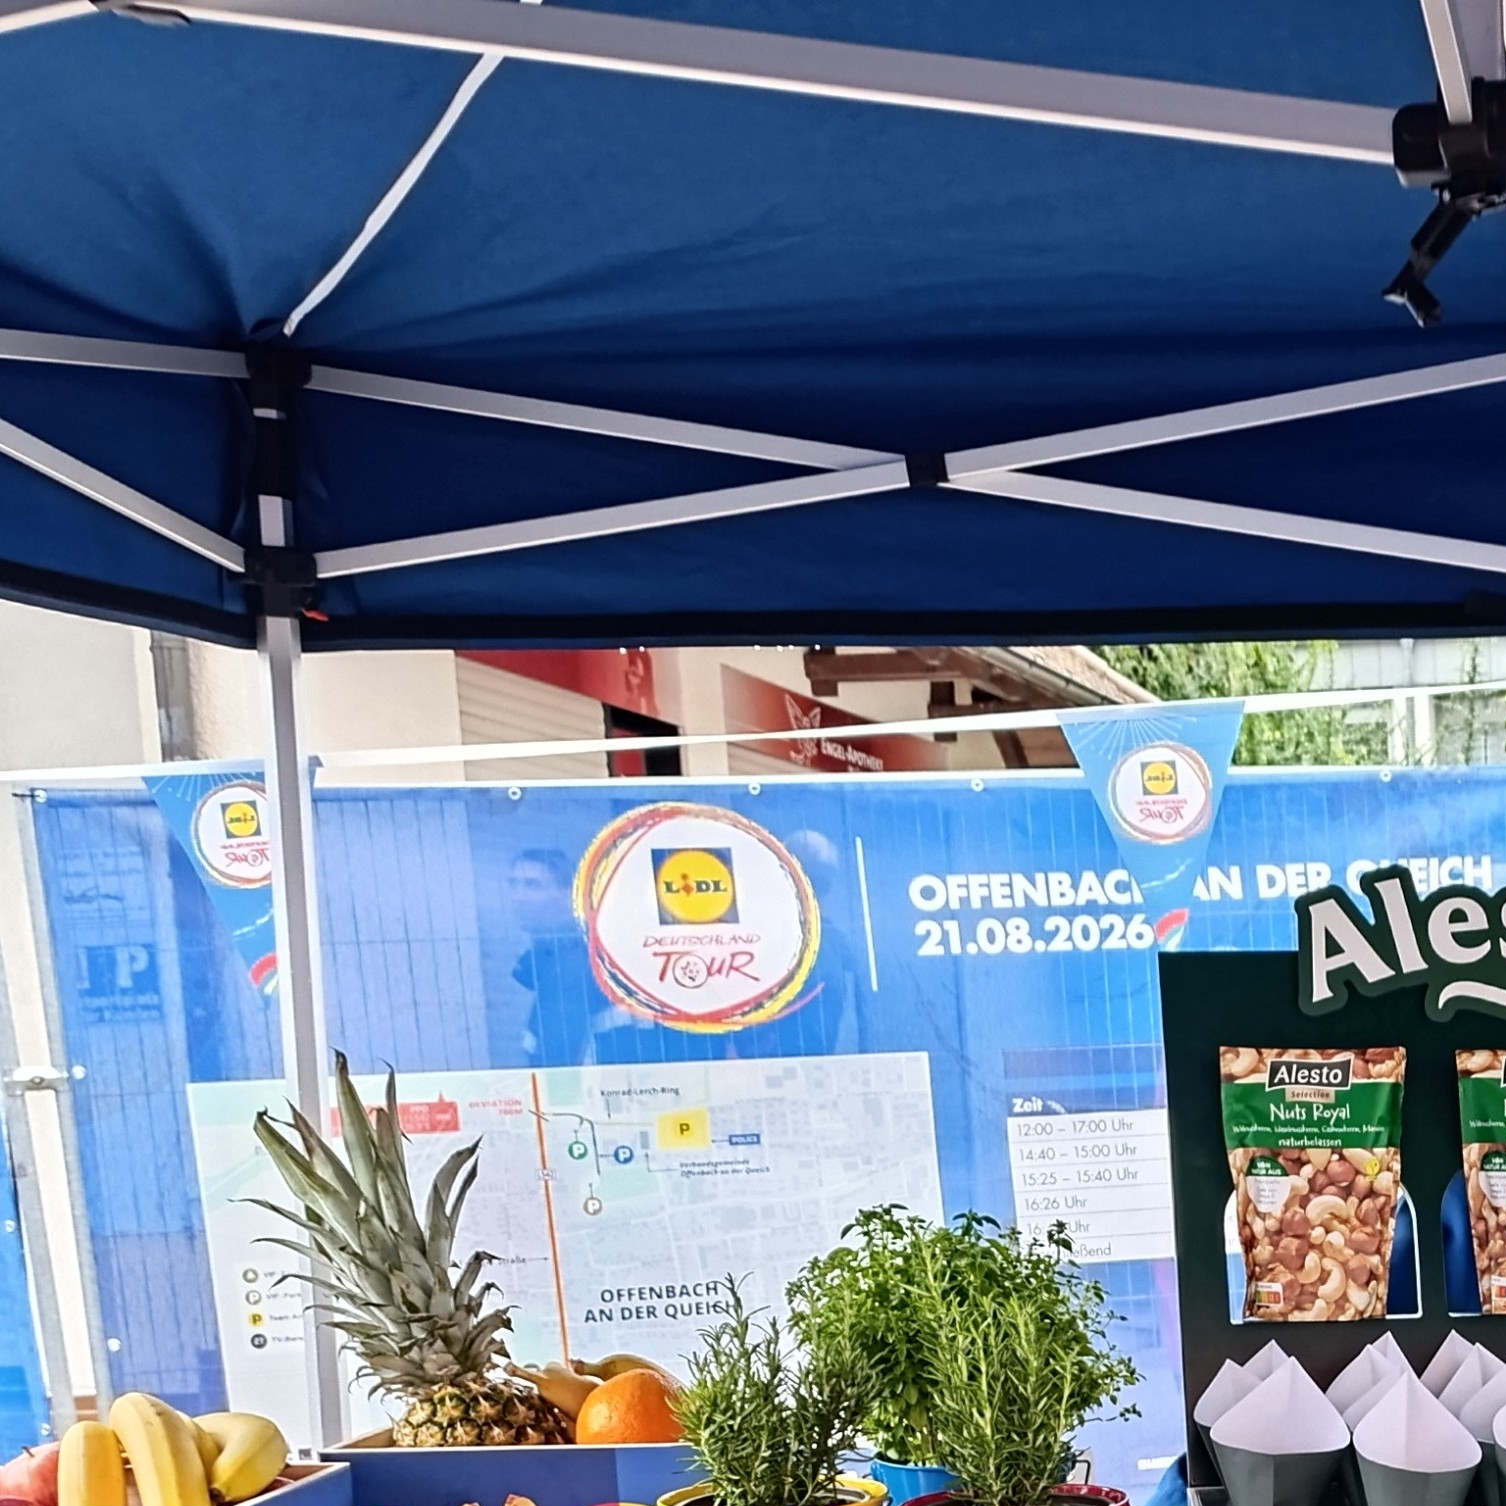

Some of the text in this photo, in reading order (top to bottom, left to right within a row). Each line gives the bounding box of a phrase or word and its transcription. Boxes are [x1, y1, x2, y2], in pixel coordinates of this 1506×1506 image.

[1256, 862, 1332, 899] DER
[1345, 854, 1493, 896] QEICH
[643, 933, 761, 947] DEUTSCHLAND
[914, 913, 1155, 956] 21.08.2026
[1273, 1064, 1343, 1084] Alesto
[600, 1086, 681, 1098] Konrad-Lerch-Ring
[1290, 1090, 1330, 1100] Selection
[1012, 1096, 1044, 1113] Zeit
[1269, 1103, 1351, 1126] Nuts Royal
[679, 1123, 690, 1135] P
[1017, 1122, 1053, 1137] 12:00
[1072, 1119, 1107, 1134] 17:00
[1112, 1117, 1134, 1132] Uhr
[1278, 1136, 1342, 1147] naturbelassen
[573, 1144, 585, 1157] P
[618, 1148, 630, 1161] P
[1019, 1146, 1055, 1161] 14:40
[1075, 1144, 1110, 1159] 15:00
[1115, 1143, 1137, 1157] Uhr
[1022, 1171, 1057, 1186] 15:25
[1076, 1169, 1112, 1183] 15:40
[1117, 1168, 1139, 1182] Uhr
[588, 1200, 600, 1213] P
[1024, 1194, 1087, 1211] 16:26 Uhr
[1069, 1219, 1090, 1233] Uhr
[600, 1282, 718, 1303] OFFENBACH
[252, 1313, 262, 1325] P
[584, 1308, 614, 1323] AN
[621, 1305, 658, 1321] DER
